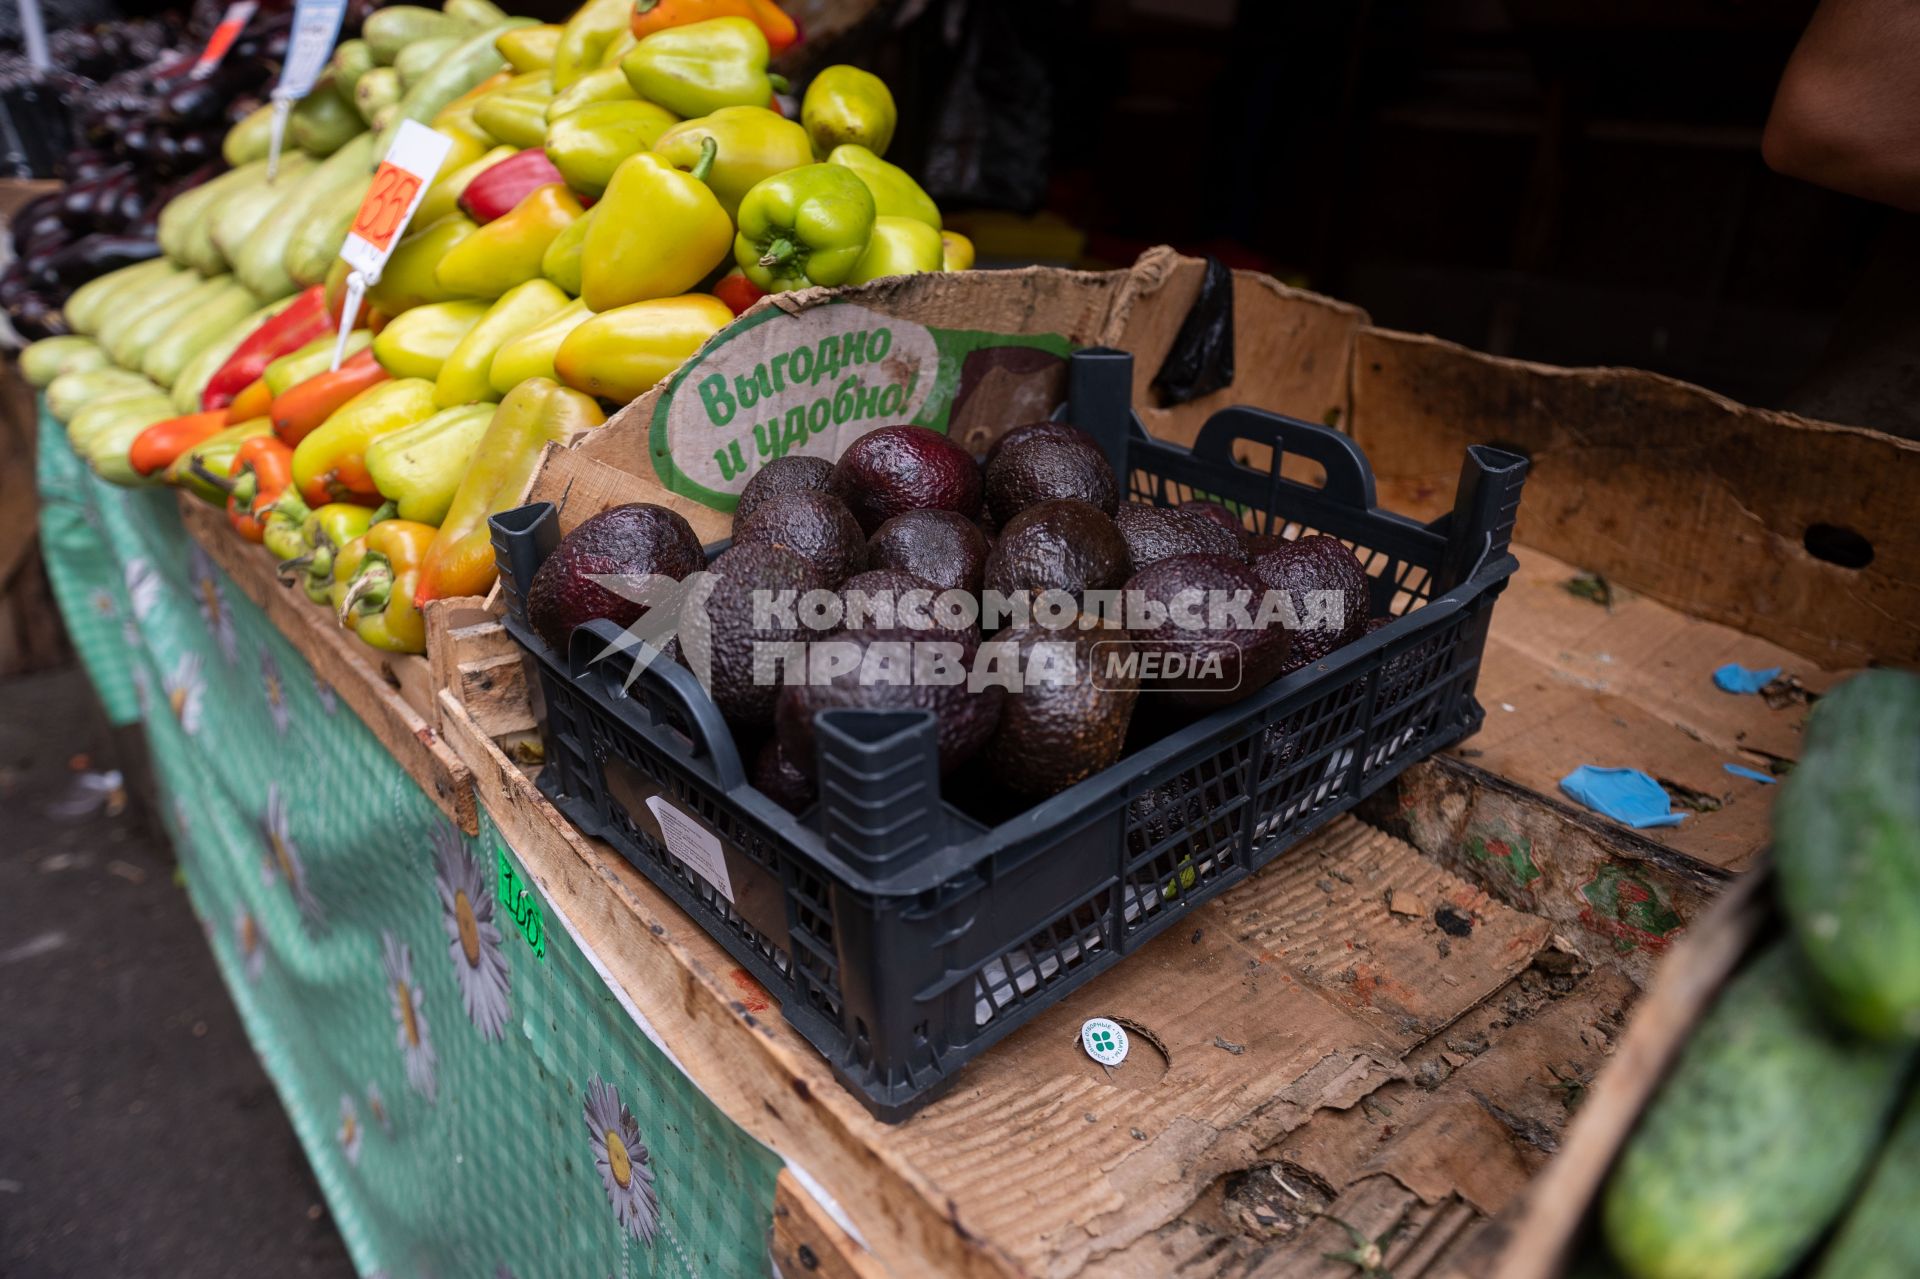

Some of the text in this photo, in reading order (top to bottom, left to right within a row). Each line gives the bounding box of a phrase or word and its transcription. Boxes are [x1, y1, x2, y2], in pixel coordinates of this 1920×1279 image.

[698, 328, 893, 427] Выгодно
[713, 369, 919, 481] и удобно!
[1114, 1031, 1124, 1057] ТОМАТЫ
